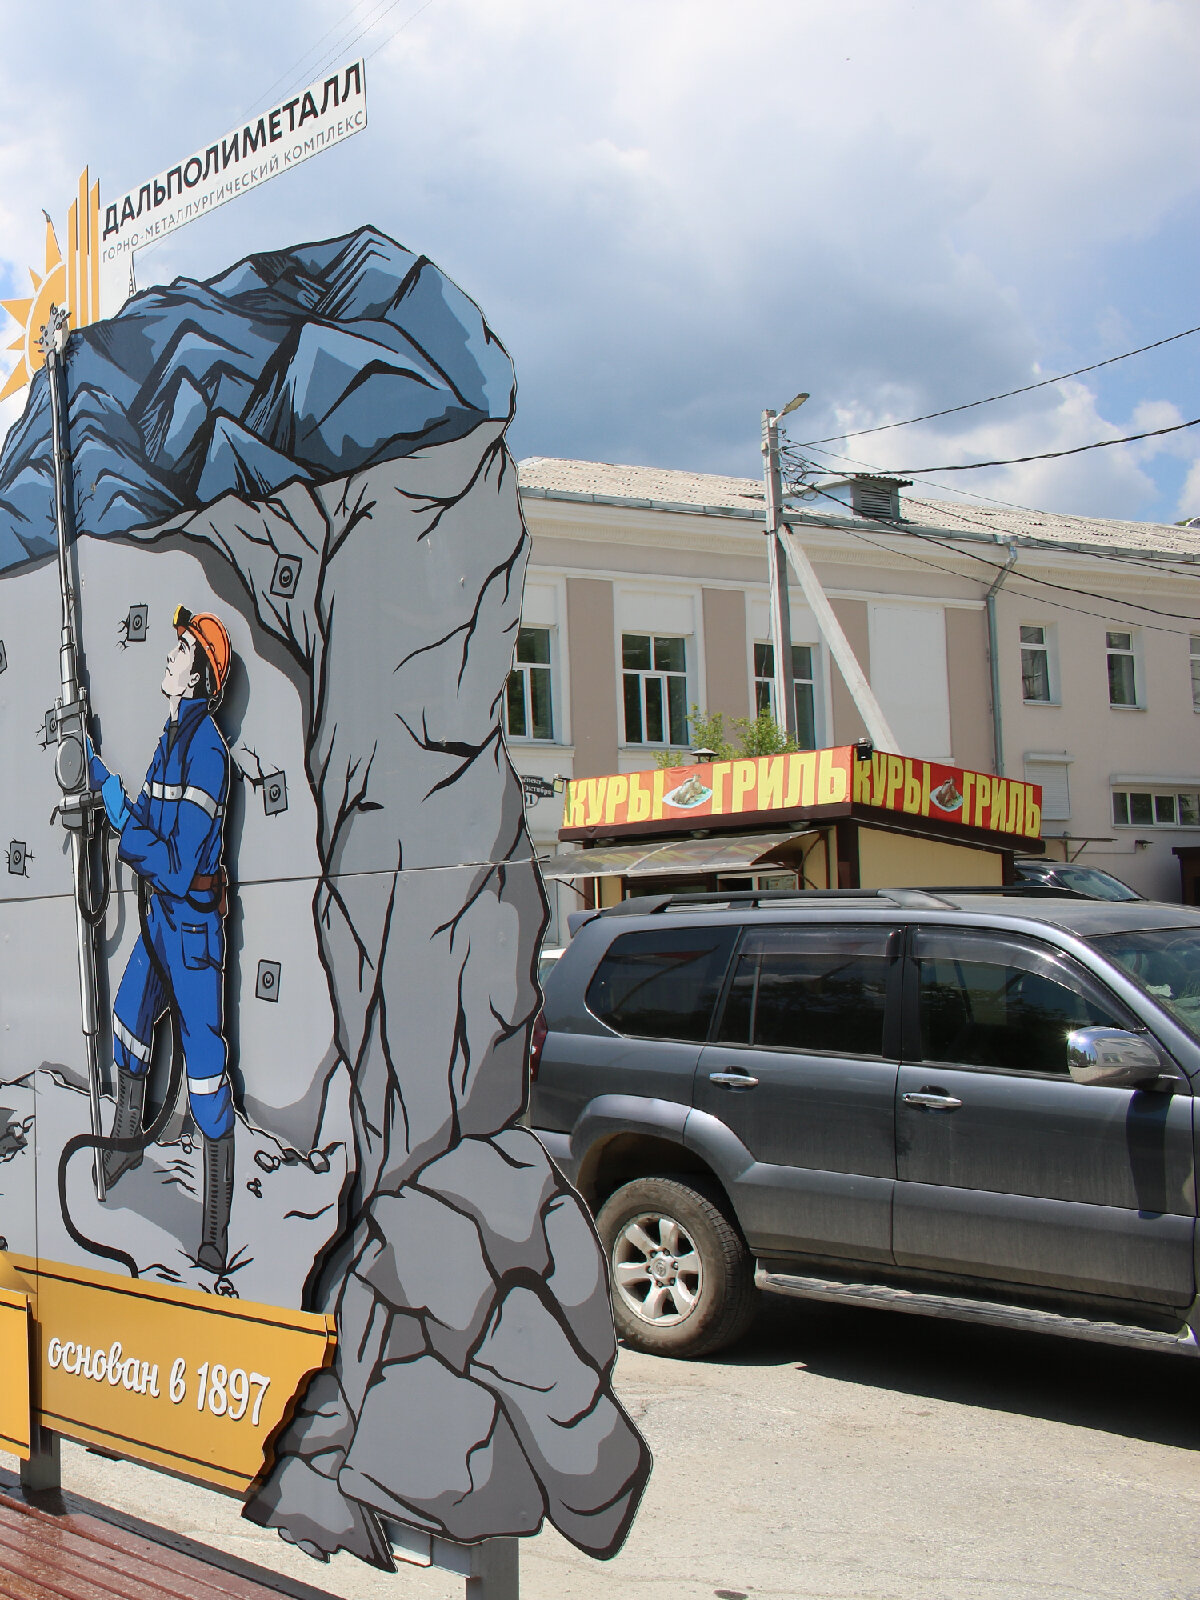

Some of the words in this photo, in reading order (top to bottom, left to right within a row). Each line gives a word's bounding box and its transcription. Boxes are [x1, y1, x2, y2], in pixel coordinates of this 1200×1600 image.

[102, 62, 362, 242] ДАЛЬПОЛИМЕТАЛЛ
[284, 110, 363, 167] КОМПЛЕКС
[564, 770, 665, 827] КУРЫ
[711, 750, 847, 815] ГРИЛЬ
[853, 748, 931, 817] КУРЫ
[961, 771, 1041, 839] ГРИЛЬ
[48, 1337, 160, 1398] основан
[168, 1357, 187, 1404] в
[197, 1361, 272, 1427] 1897
